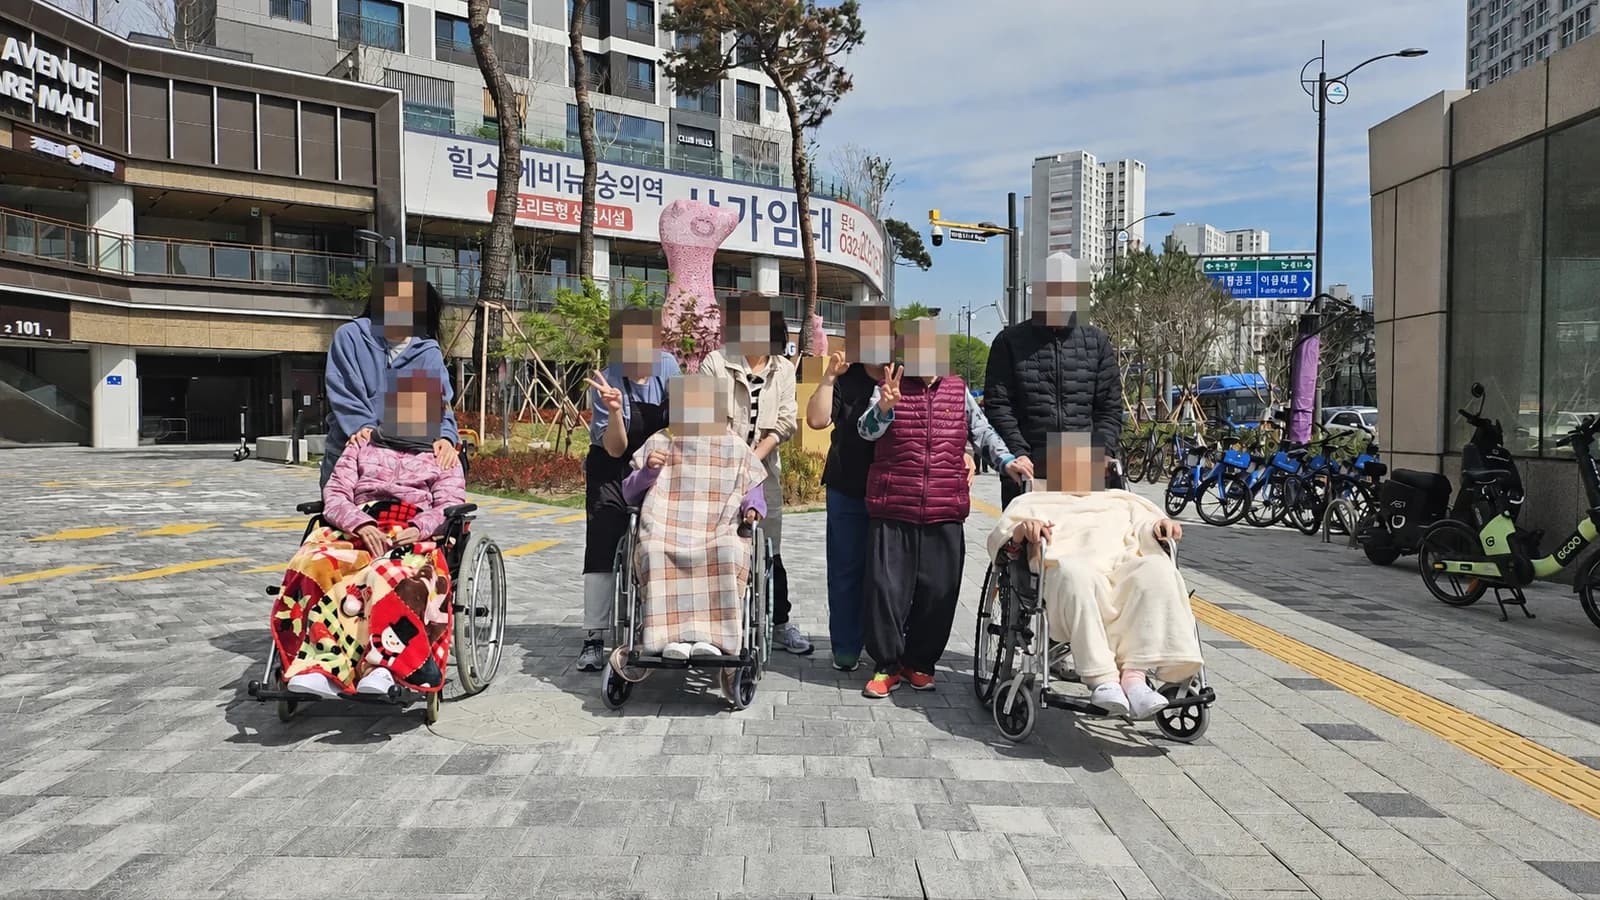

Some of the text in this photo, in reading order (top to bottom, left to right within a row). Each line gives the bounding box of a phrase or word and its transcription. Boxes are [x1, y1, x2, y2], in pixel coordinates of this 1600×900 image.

[1, 37, 99, 96] AVENUE
[38, 84, 99, 127] MALL
[16, 320, 40, 336] 101
[1557, 535, 1582, 560] GCOO
